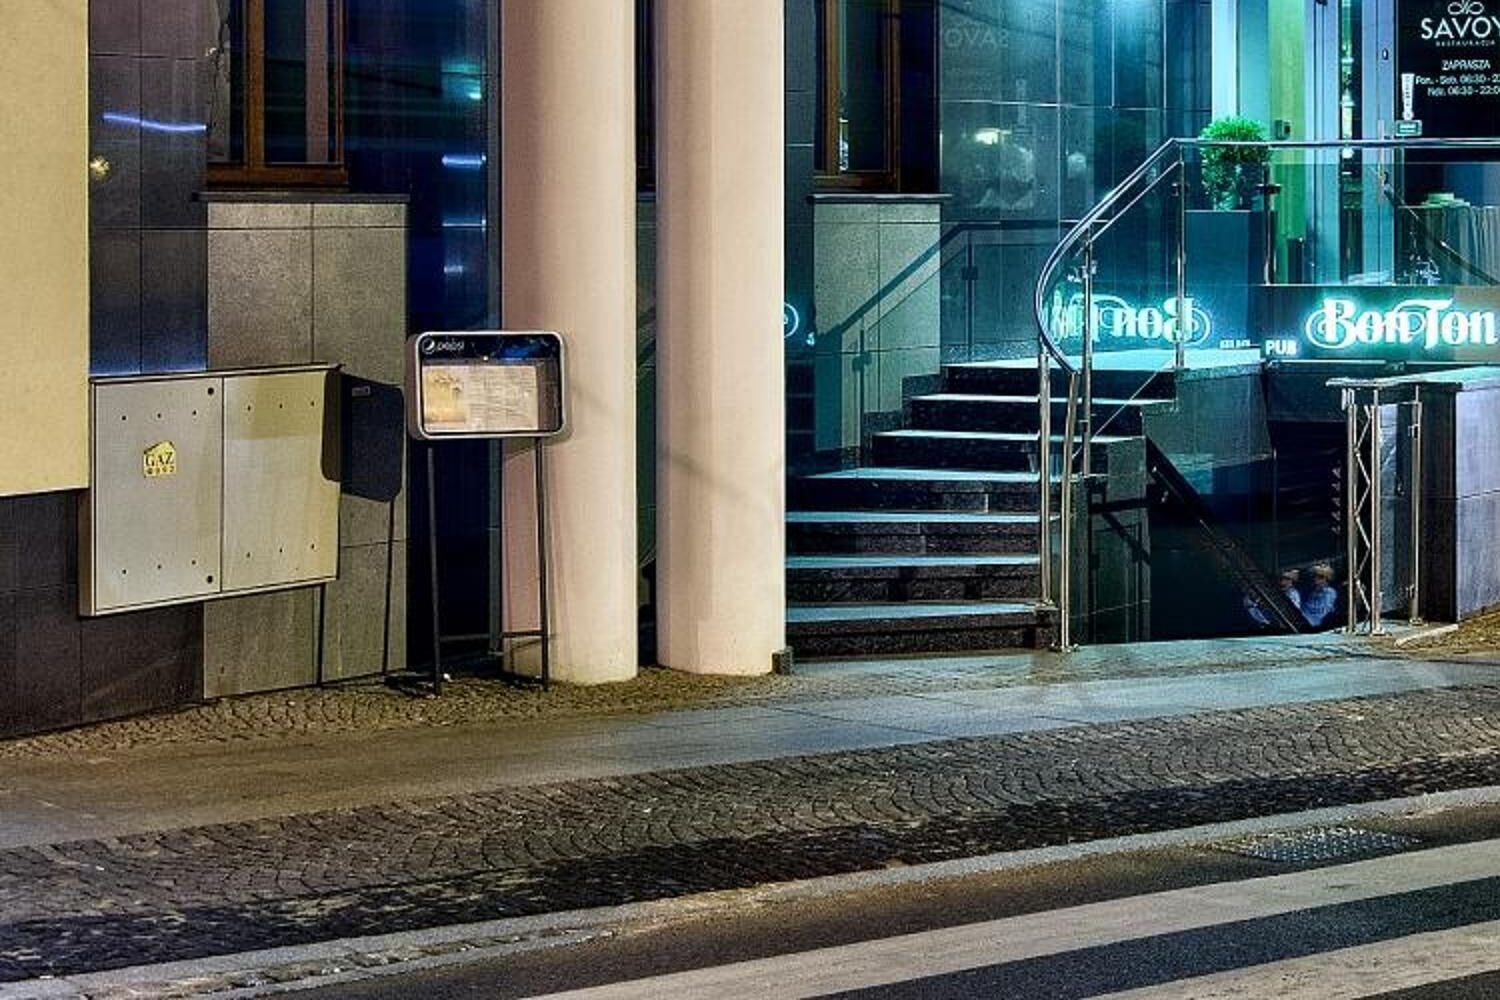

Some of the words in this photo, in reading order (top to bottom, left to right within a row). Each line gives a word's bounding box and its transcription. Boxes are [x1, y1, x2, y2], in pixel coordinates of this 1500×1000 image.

[1441, 59, 1491, 71] ZAPRASZA
[1265, 339, 1297, 355] PUB
[146, 451, 174, 466] GAZ
